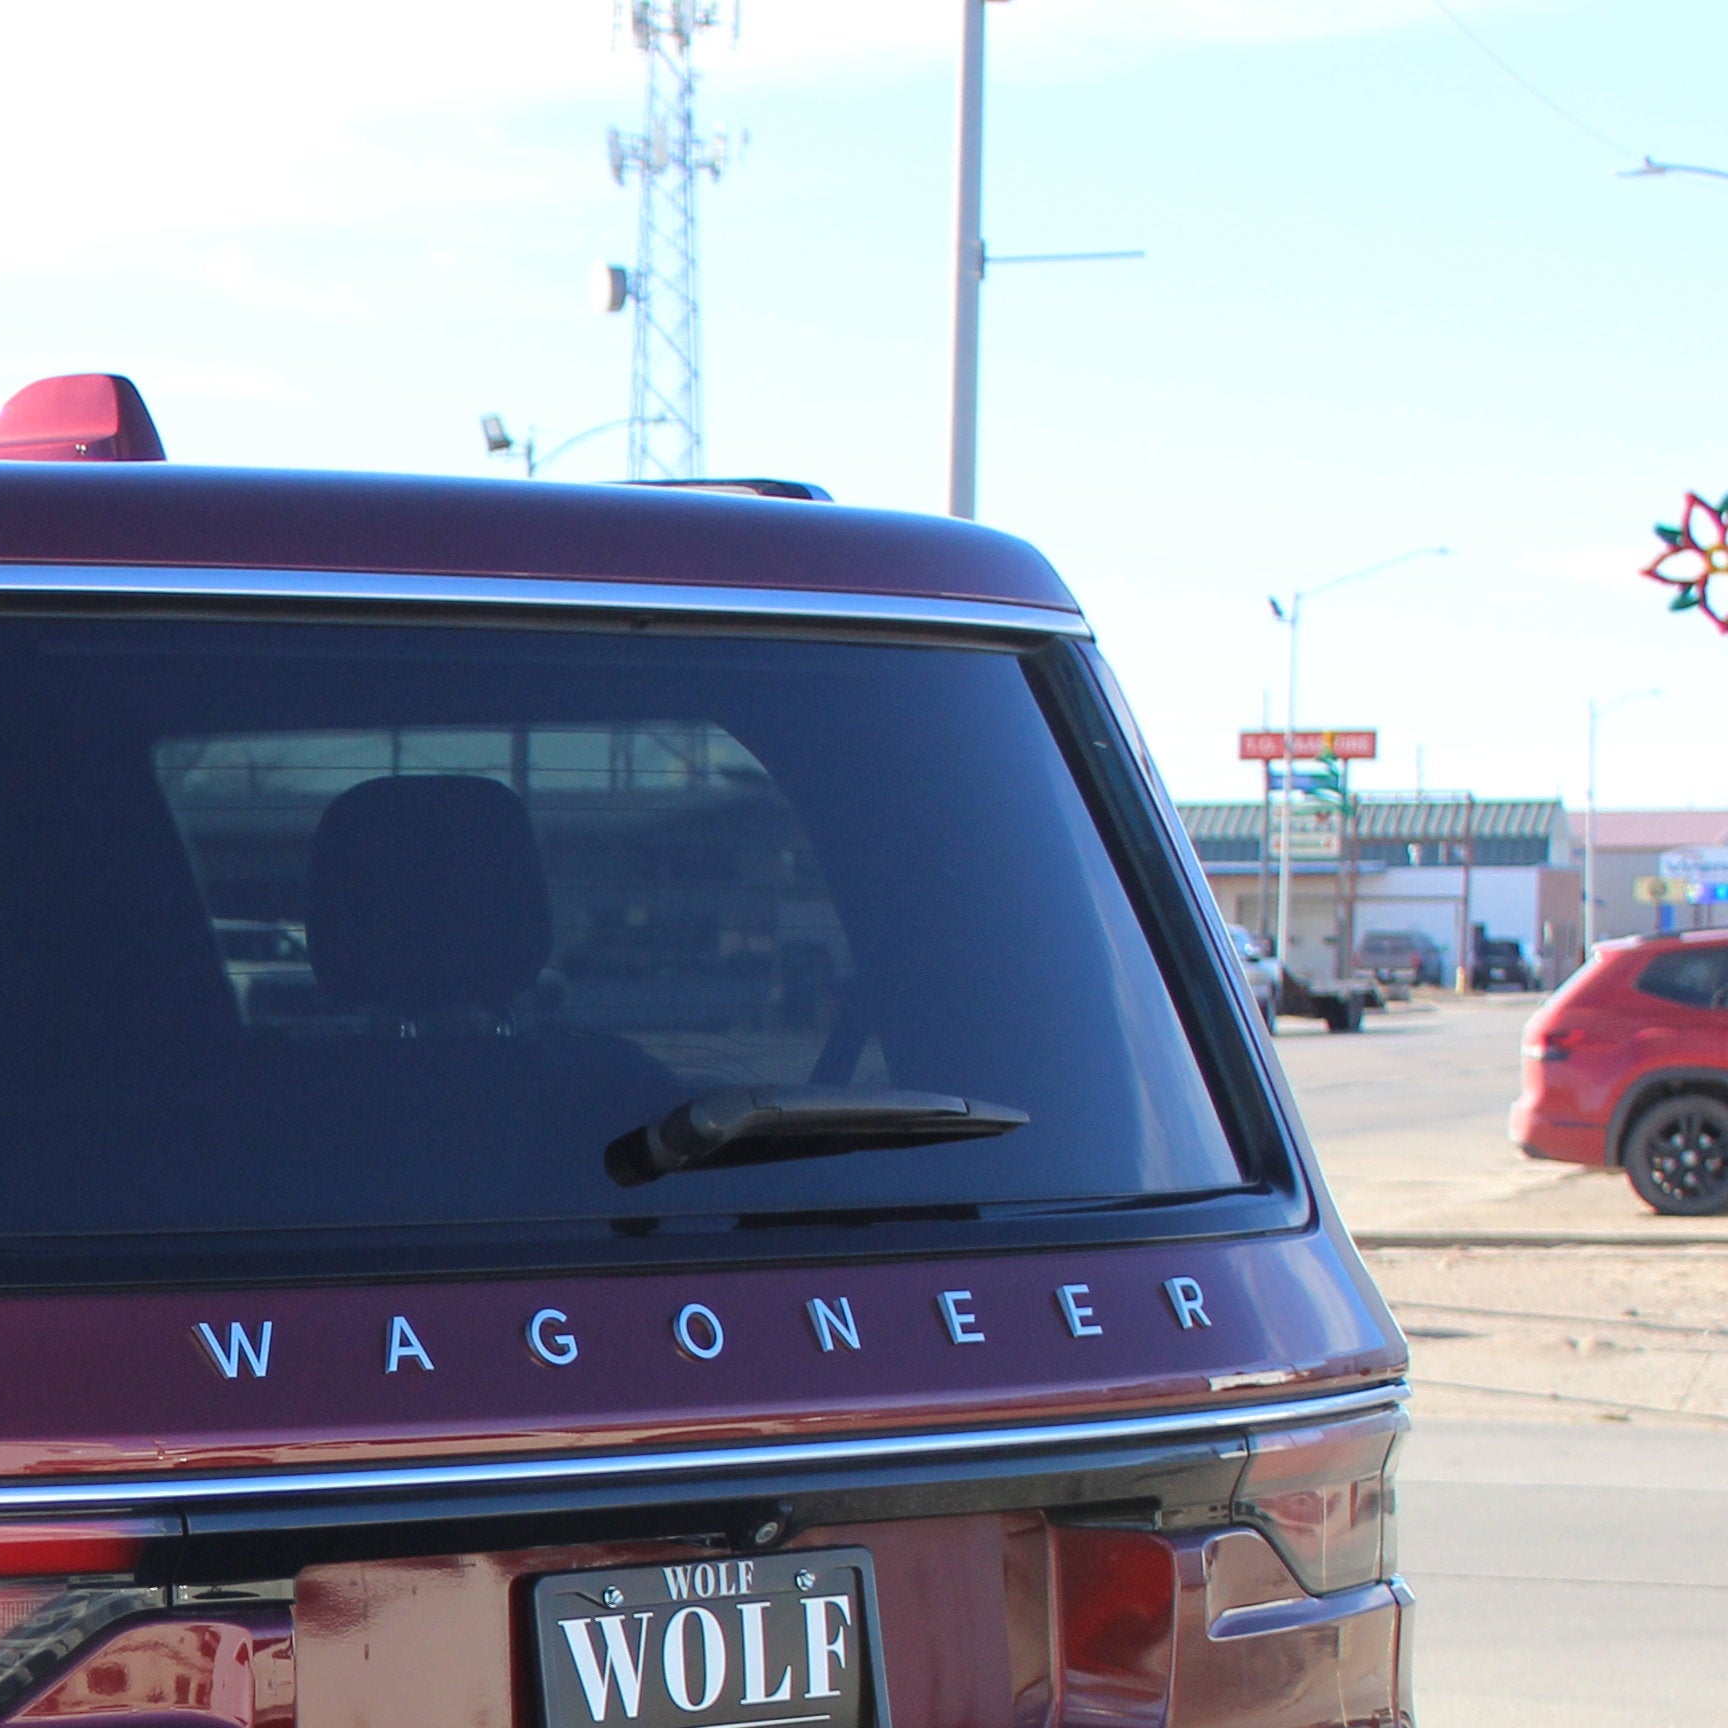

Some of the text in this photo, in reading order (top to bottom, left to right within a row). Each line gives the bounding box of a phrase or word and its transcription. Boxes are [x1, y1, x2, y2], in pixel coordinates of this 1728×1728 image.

[192, 1275, 1212, 1380] WAGONEER
[663, 1560, 755, 1600] WOLF
[558, 1594, 852, 1722] WOLF
